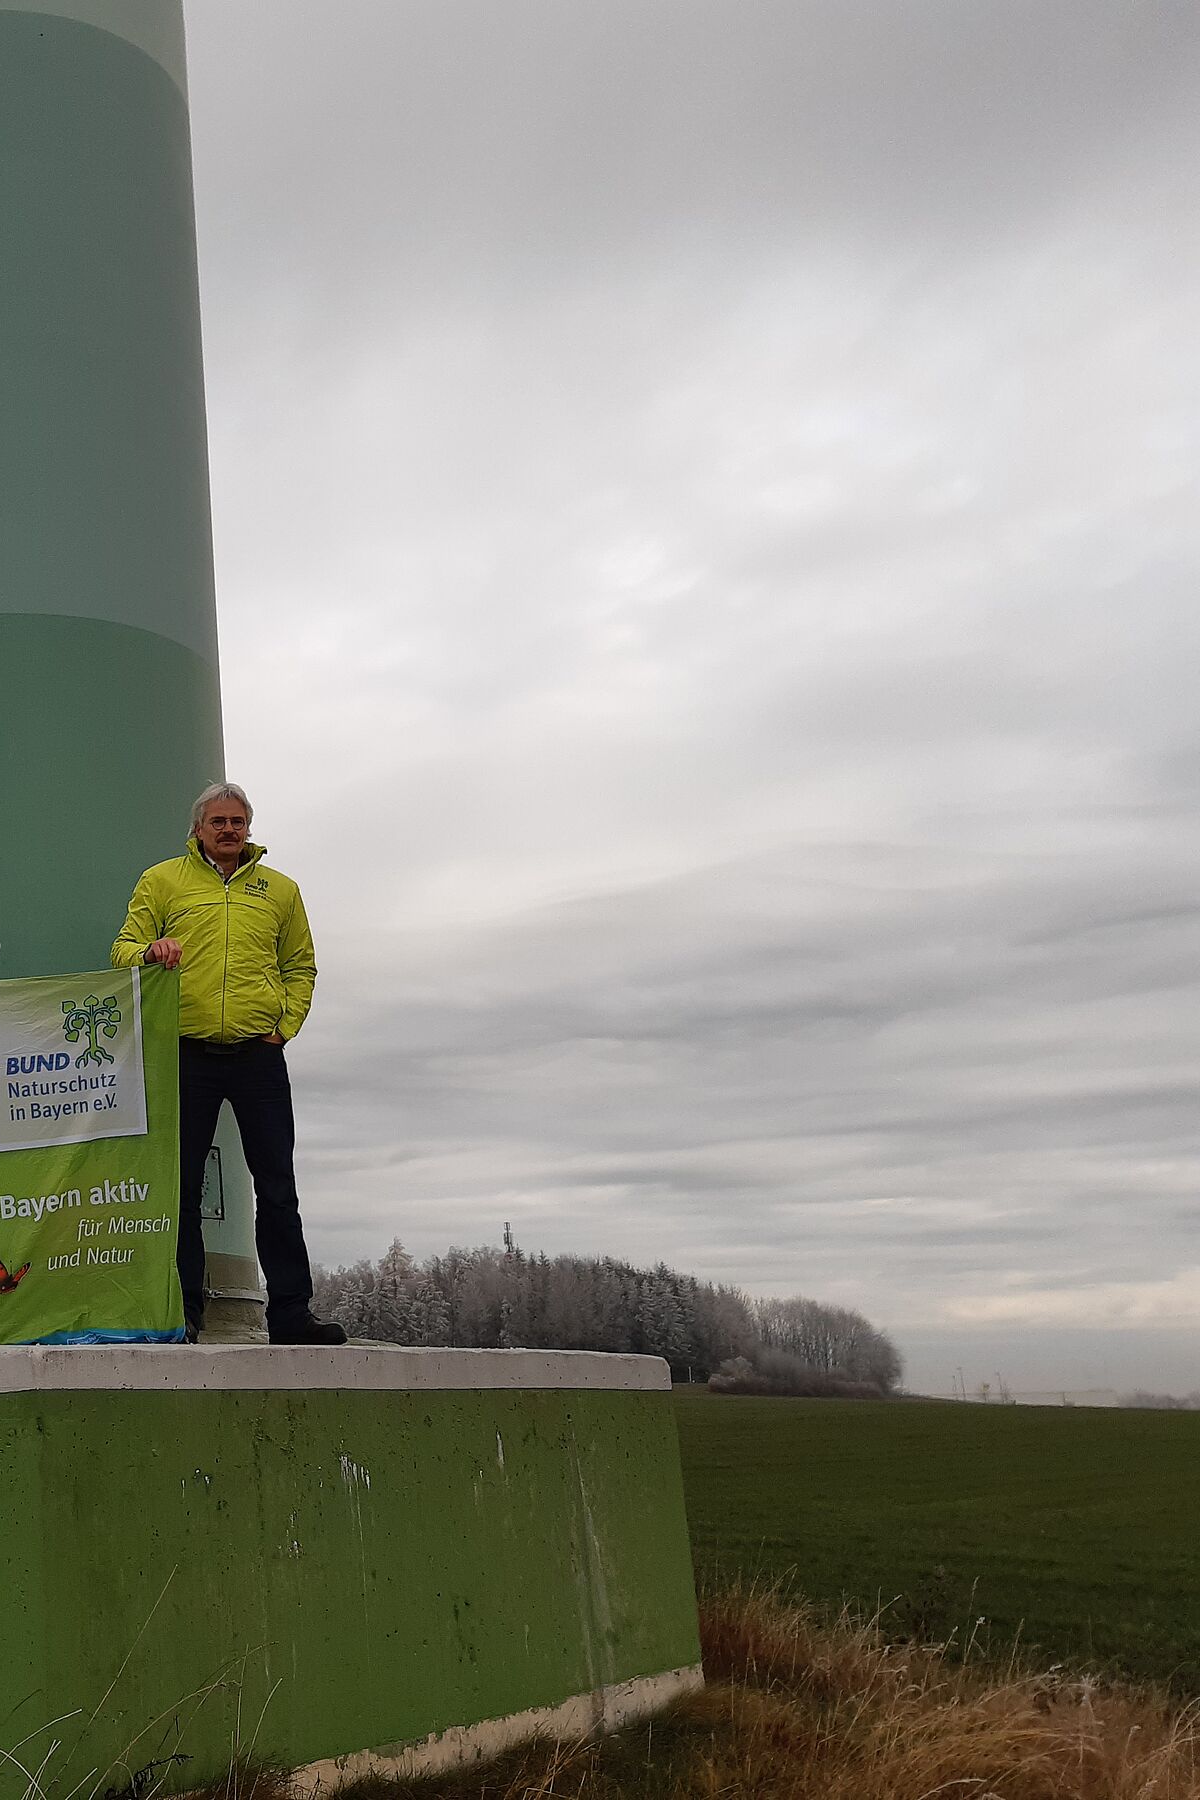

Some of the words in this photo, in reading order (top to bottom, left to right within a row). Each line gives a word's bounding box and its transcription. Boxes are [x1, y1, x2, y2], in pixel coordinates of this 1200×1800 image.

[6, 1053, 70, 1075] BUND
[8, 1073, 117, 1098] Naturschutz
[10, 1104, 25, 1121] in
[31, 1100, 89, 1120] Bayern
[93, 1093, 117, 1110] e.V.
[0, 1188, 81, 1222] Bayern
[89, 1177, 149, 1205] aktiv
[77, 1218, 103, 1241] für
[108, 1213, 171, 1234] Mensch
[48, 1250, 80, 1271] und
[86, 1247, 135, 1265] Natur
